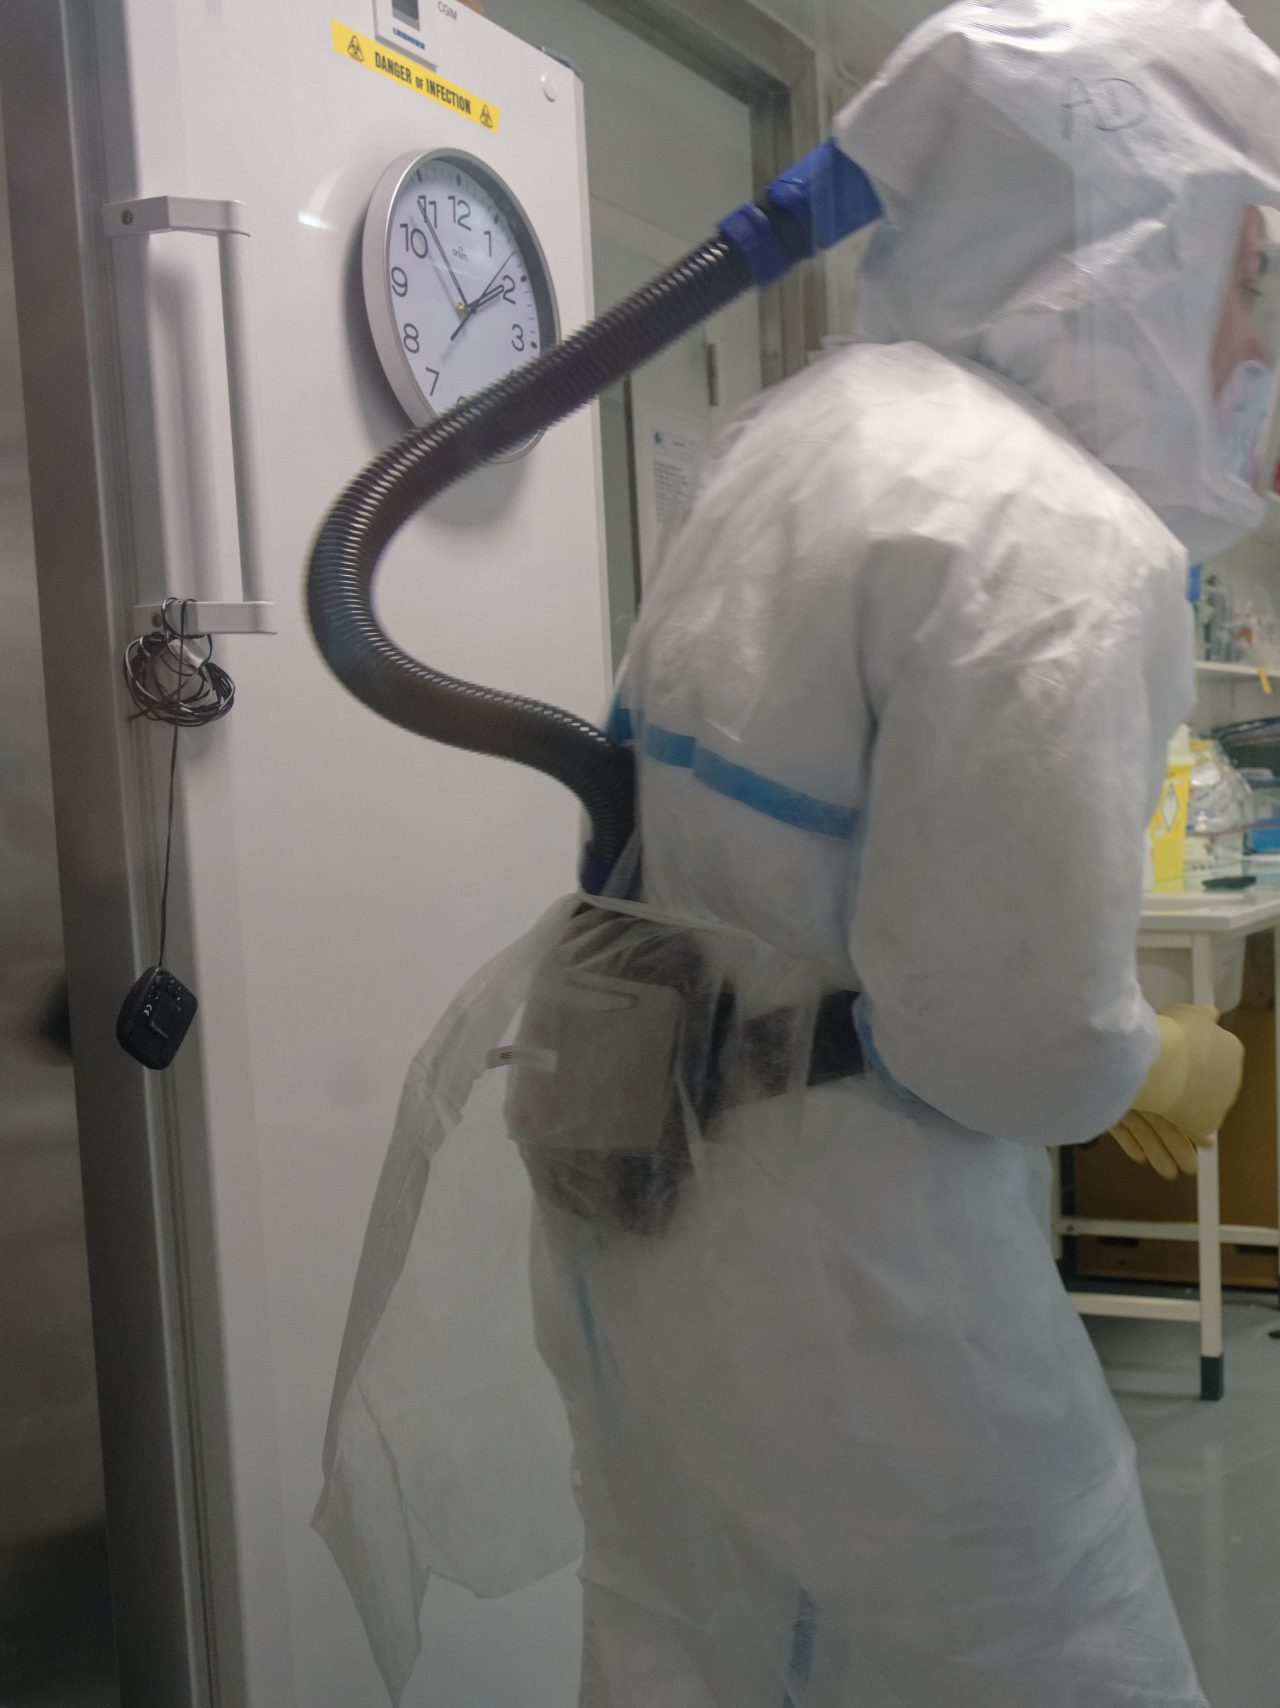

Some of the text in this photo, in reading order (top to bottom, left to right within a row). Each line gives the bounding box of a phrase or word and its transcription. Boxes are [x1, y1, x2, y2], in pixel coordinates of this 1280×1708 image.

[375, 51, 412, 84] DANGER
[426, 78, 472, 115] INFECTION
[448, 195, 471, 231] 12
[400, 223, 428, 258] 10
[484, 231, 492, 257] 1
[391, 267, 408, 297] 9
[502, 274, 516, 305] 2
[403, 323, 420, 353] 8
[511, 324, 524, 351] 3
[425, 366, 440, 396] 7
